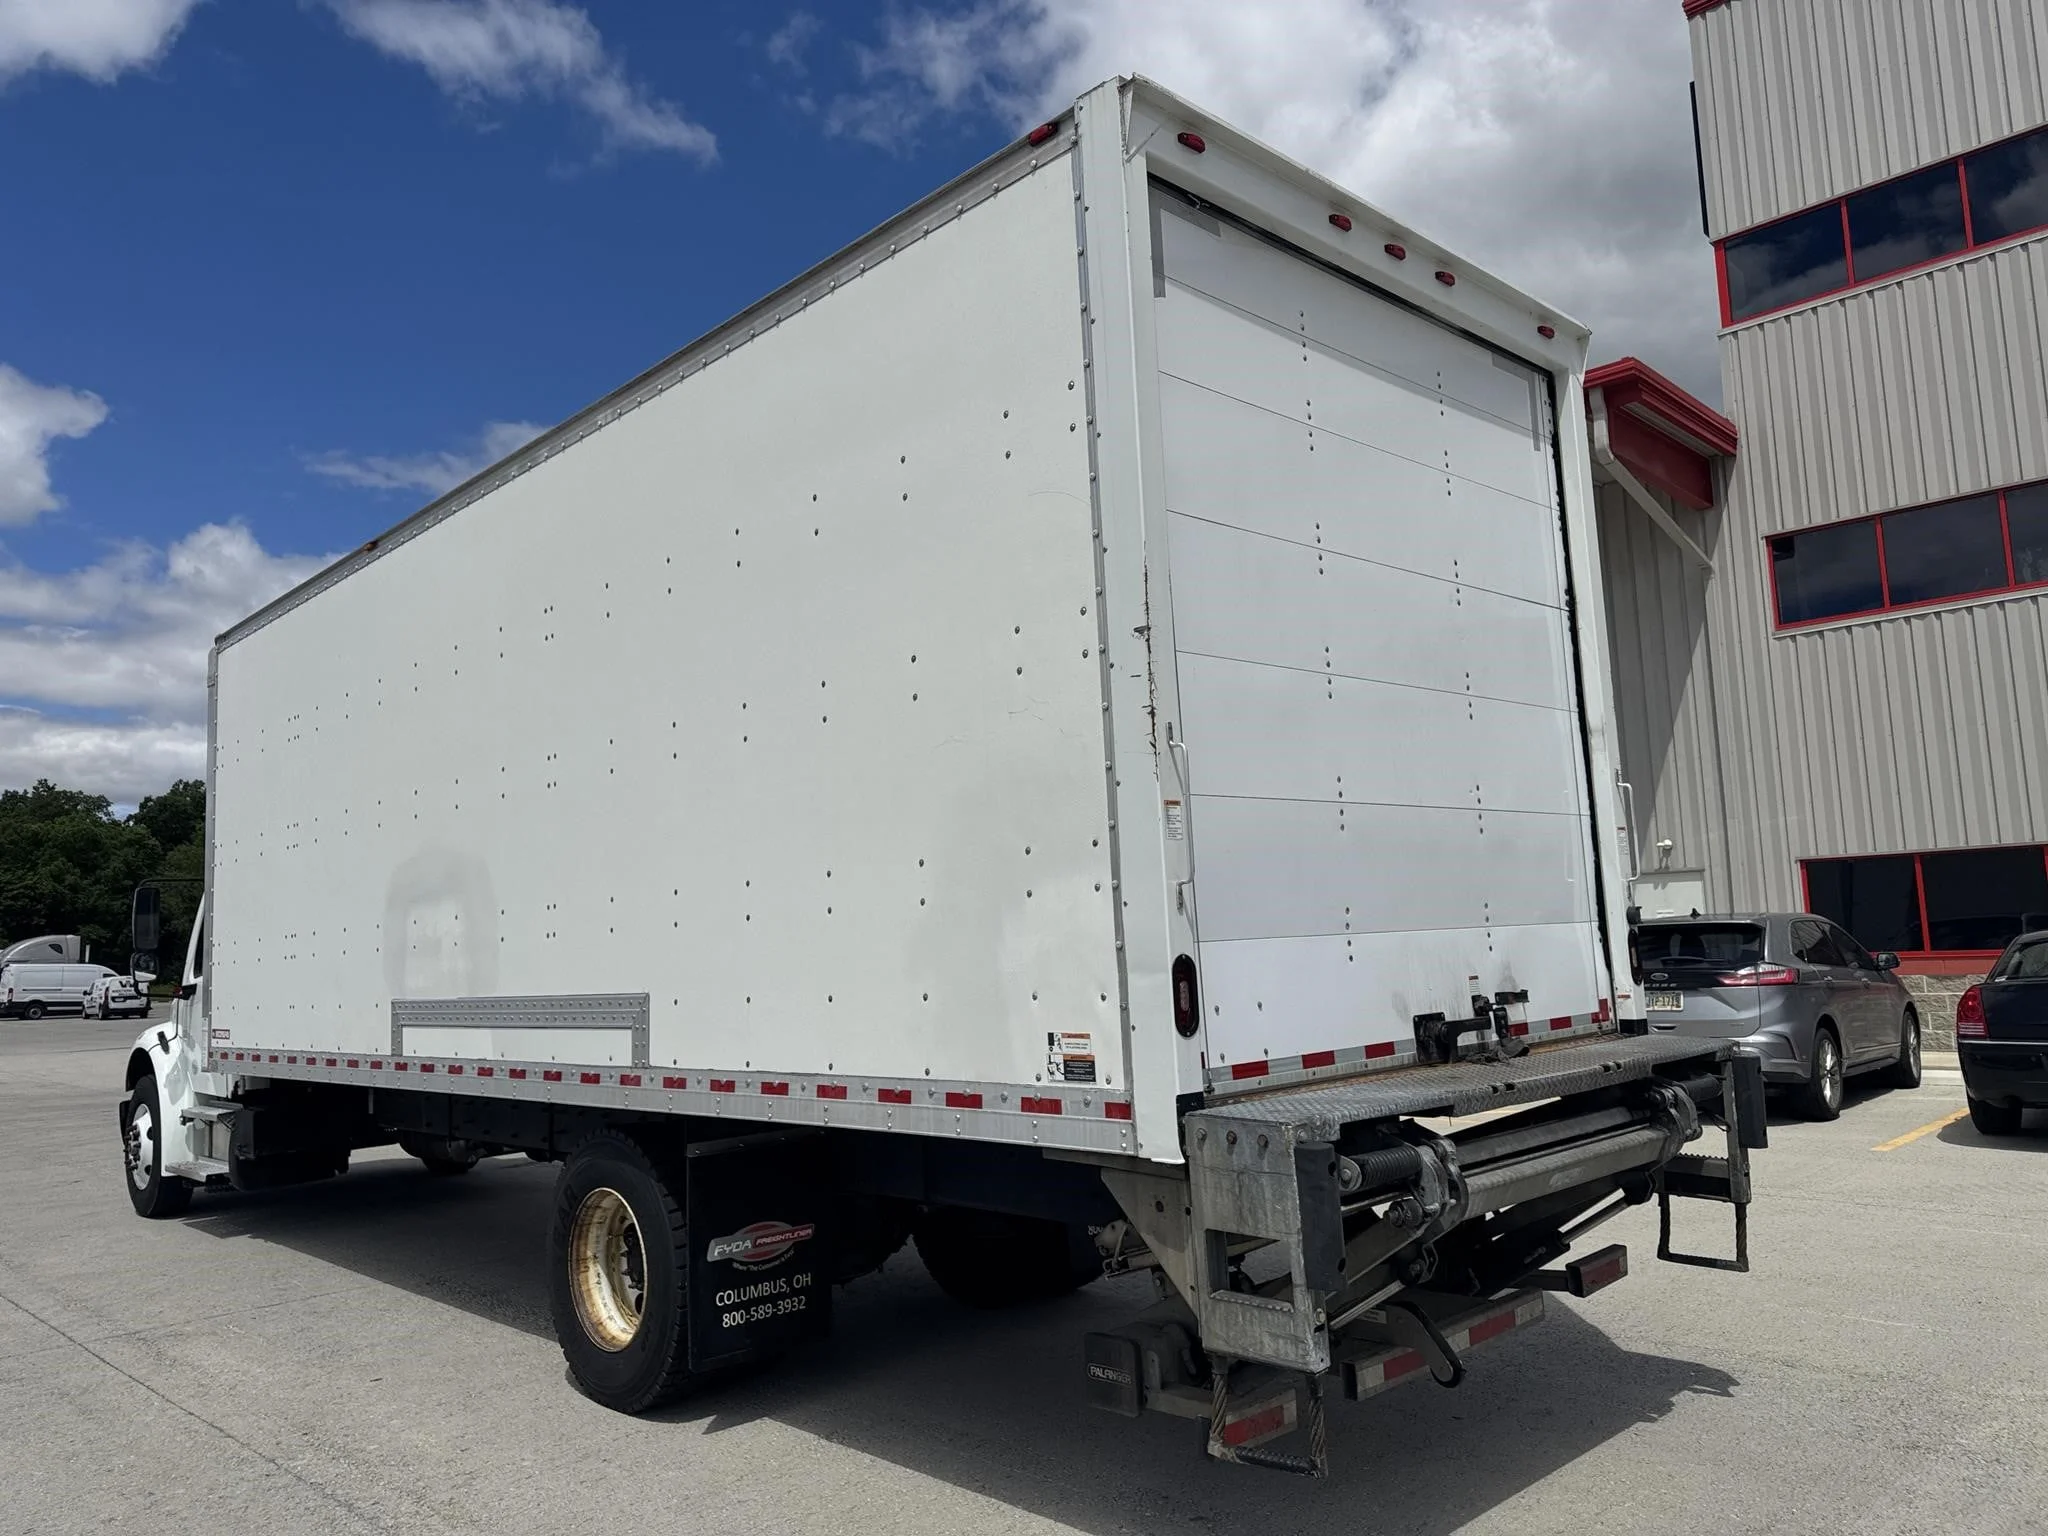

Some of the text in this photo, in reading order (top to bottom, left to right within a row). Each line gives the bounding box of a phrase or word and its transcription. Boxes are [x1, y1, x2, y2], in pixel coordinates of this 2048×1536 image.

[714, 1228, 813, 1257] FYDA FREIGHTLINER
[715, 1272, 812, 1306] COLUMBUS, OH
[722, 1296, 806, 1328] 800-589-3932
